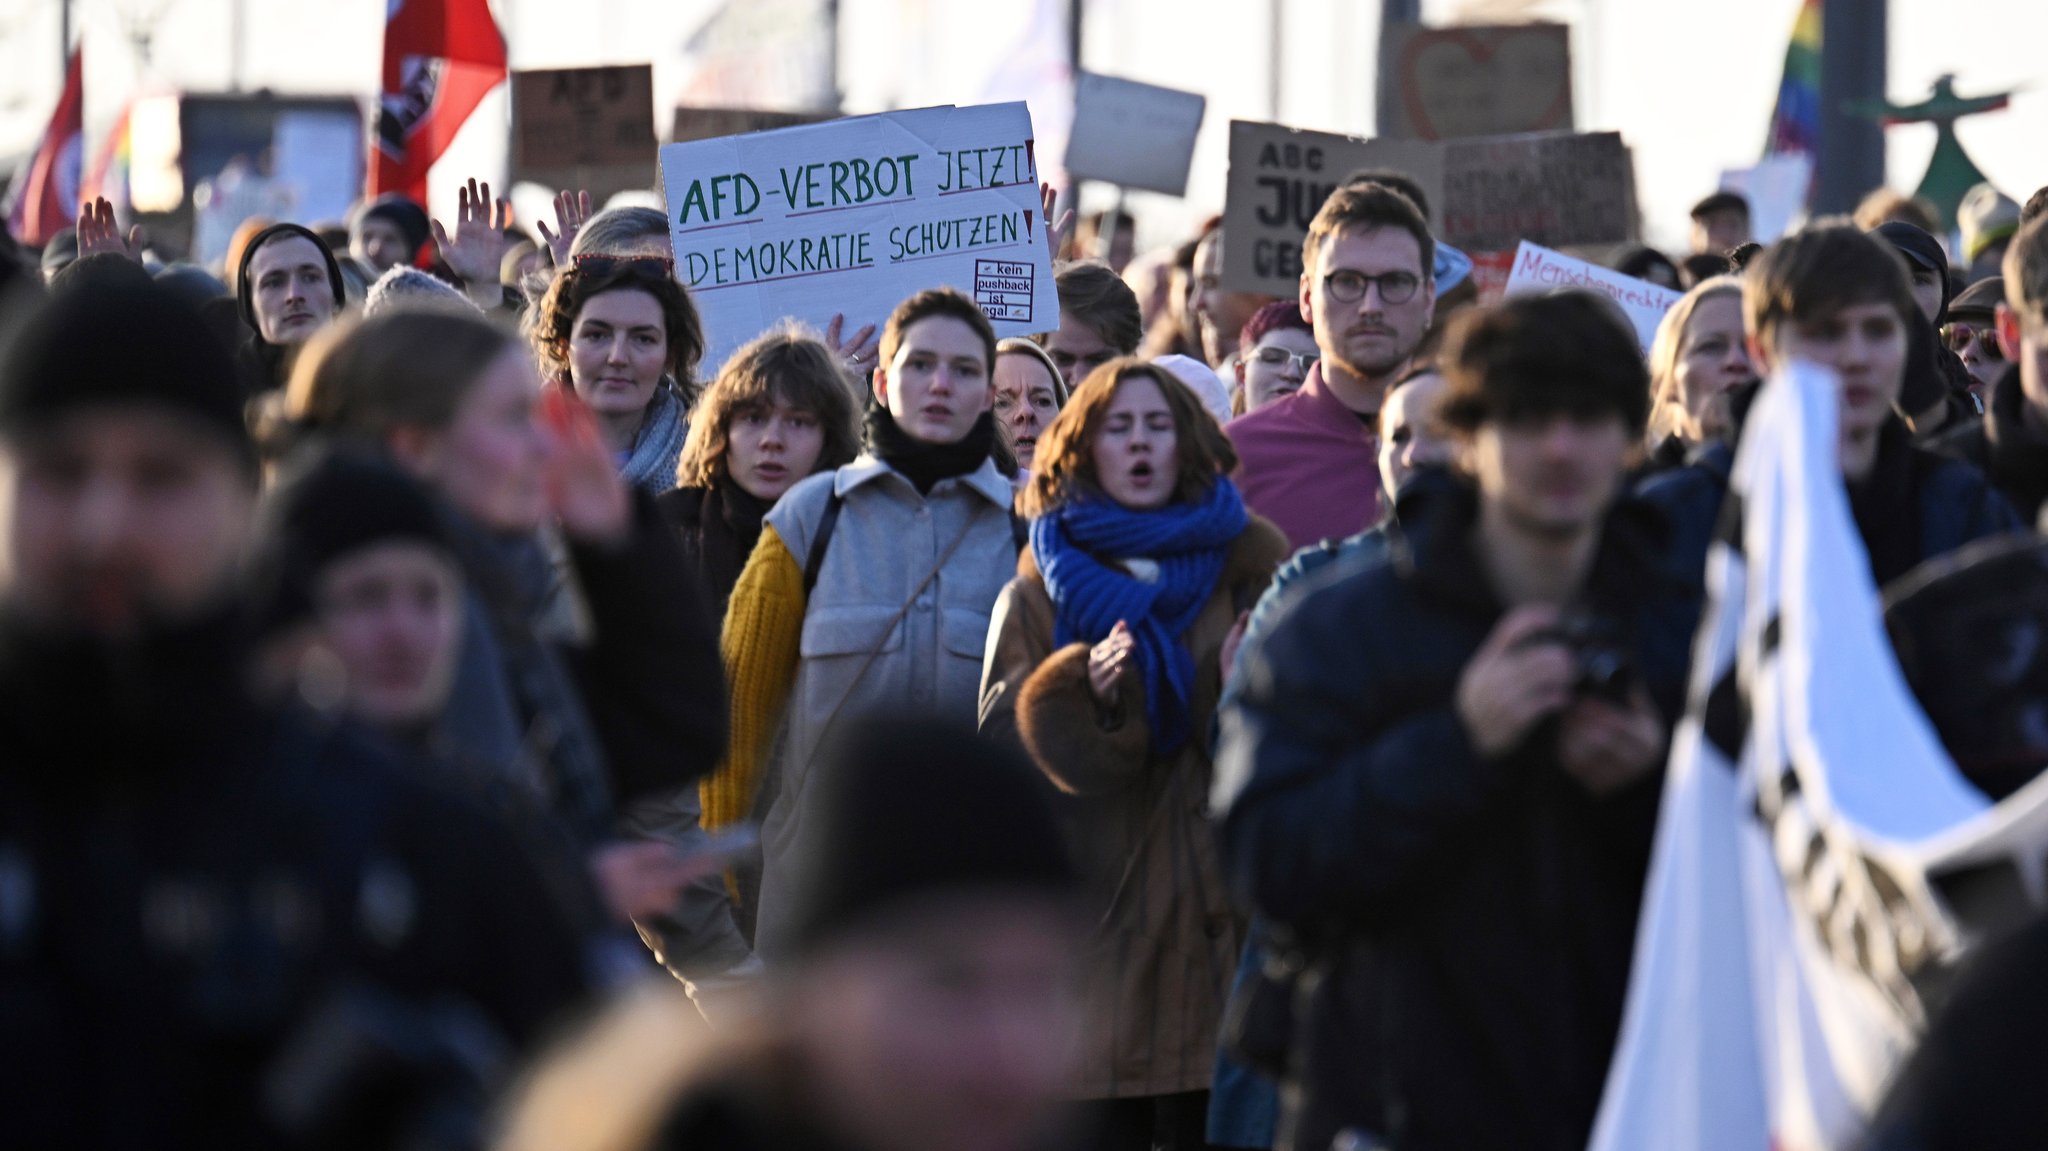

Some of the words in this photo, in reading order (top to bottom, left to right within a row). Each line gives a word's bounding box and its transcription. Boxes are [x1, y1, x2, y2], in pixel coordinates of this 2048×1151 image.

[679, 153, 919, 225] AFD-VERBOT
[937, 139, 1034, 191] JETZT!
[1255, 176, 1338, 232] JU
[684, 232, 873, 286] DEMOKRATIE
[889, 209, 1033, 261] SCHÜTZEN!
[979, 278, 1030, 291] pushback
[997, 261, 1023, 275] kein
[989, 291, 1005, 304] ist
